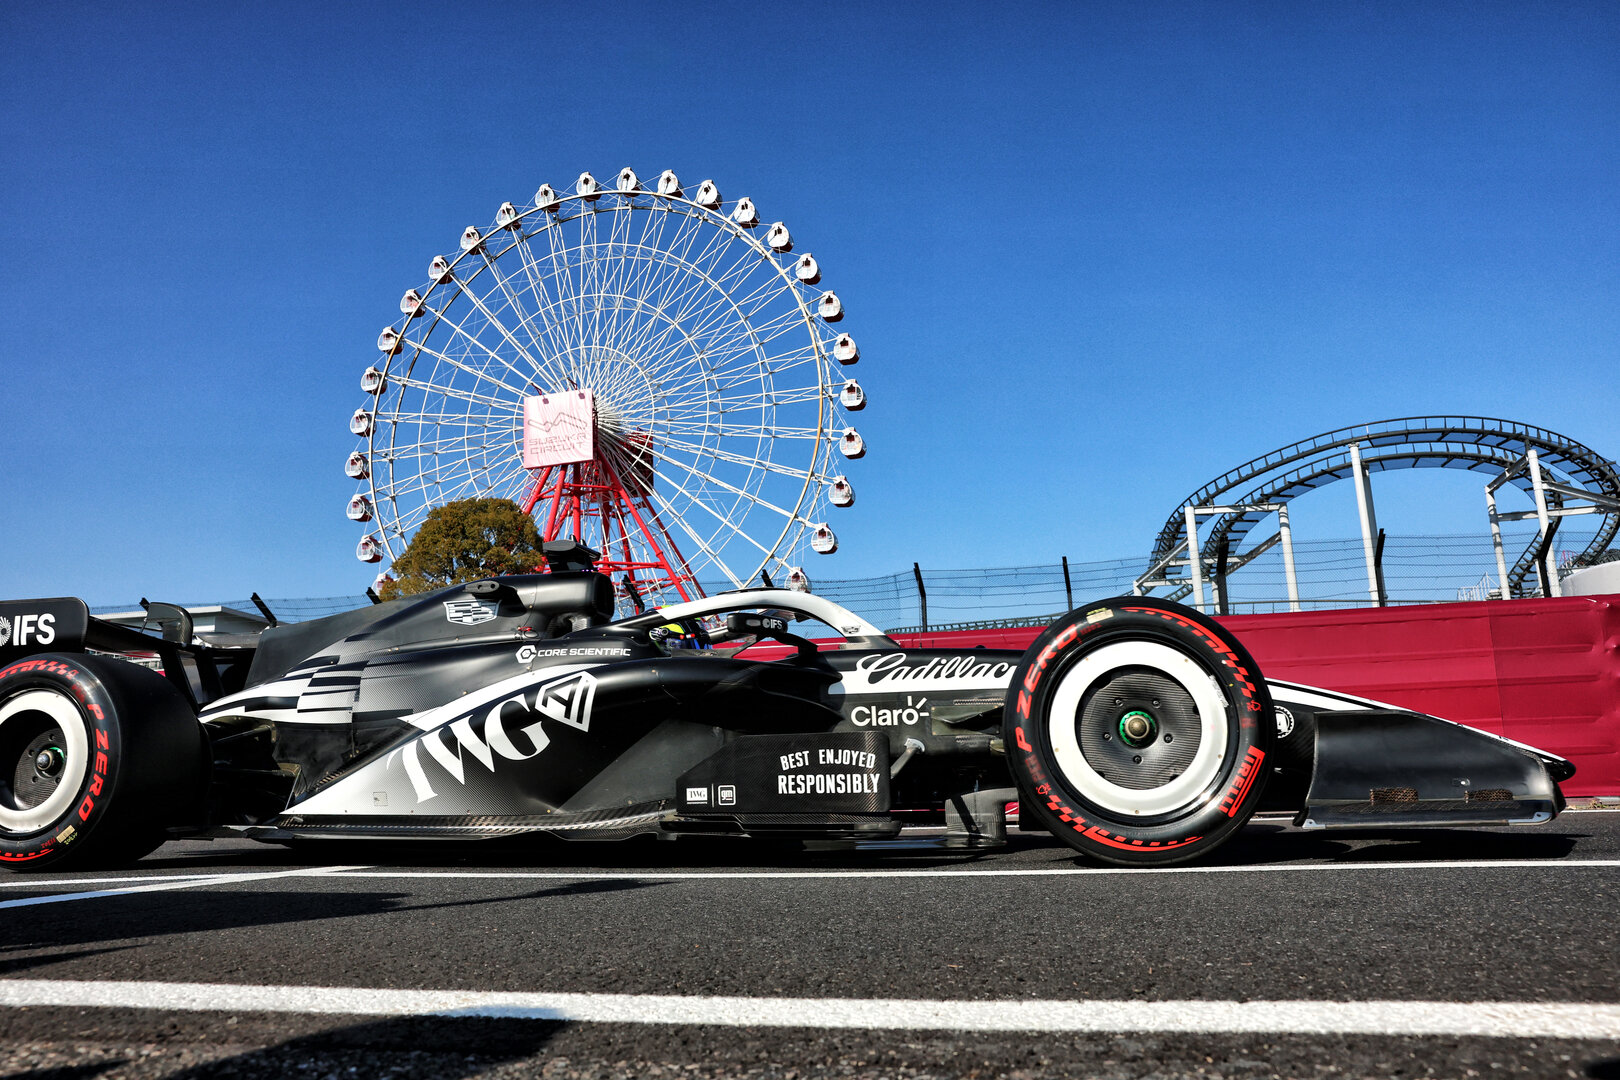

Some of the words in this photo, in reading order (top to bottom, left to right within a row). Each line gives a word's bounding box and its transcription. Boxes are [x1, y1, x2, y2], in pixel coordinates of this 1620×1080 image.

[13, 613, 56, 646] IFS
[770, 619, 783, 630] IFS
[537, 648, 568, 657] CORE
[569, 648, 631, 657] SCIENTIFIC
[856, 653, 1011, 685] Cadillac
[1016, 623, 1079, 719] ZERO
[87, 704, 105, 720] P
[851, 705, 919, 727] Claro
[386, 693, 551, 803] TWG
[1015, 727, 1033, 752] P
[780, 750, 809, 771] BEST
[818, 748, 876, 769] ENJOYED
[78, 729, 109, 822] ZERO
[778, 773, 880, 794] RESPONSIBLY
[1218, 745, 1266, 817] PIRELLI
[689, 790, 706, 799] TWG
